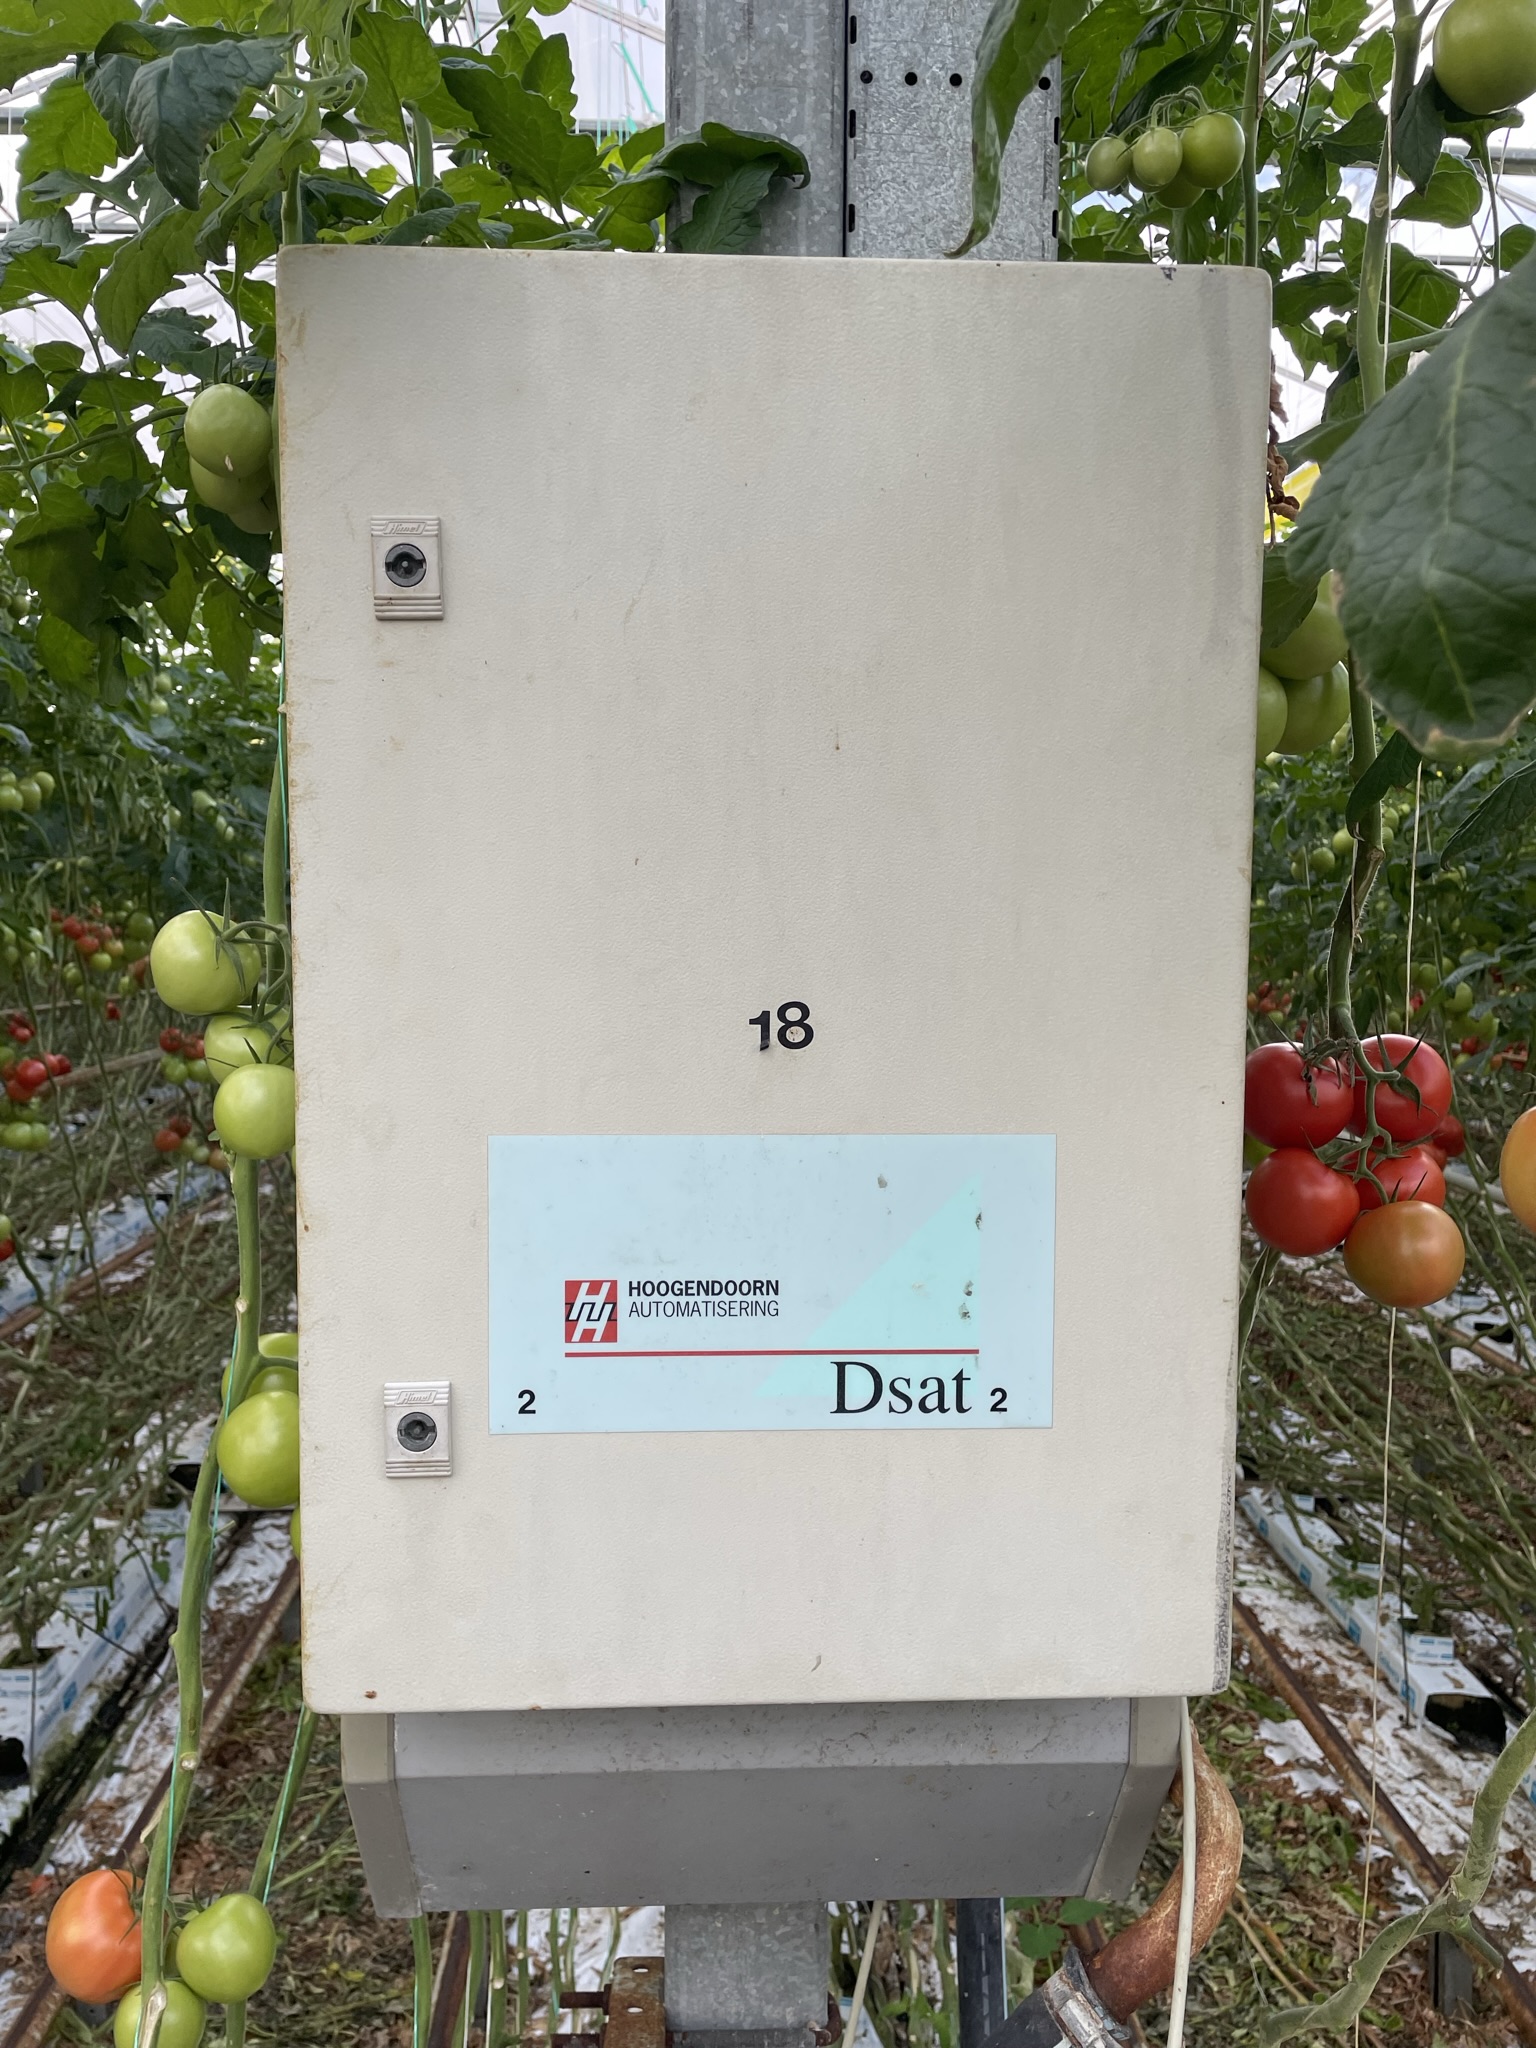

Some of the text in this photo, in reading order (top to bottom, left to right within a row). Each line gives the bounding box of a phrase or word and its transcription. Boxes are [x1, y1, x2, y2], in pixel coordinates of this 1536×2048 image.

[748, 1001, 814, 1051] 18
[628, 1280, 779, 1297] HOOGENDOORN
[628, 1300, 779, 1318] AUTOMATISERING
[830, 1361, 972, 1414] Dsat
[989, 1387, 1008, 1413] 2
[517, 1390, 536, 1415] 2
